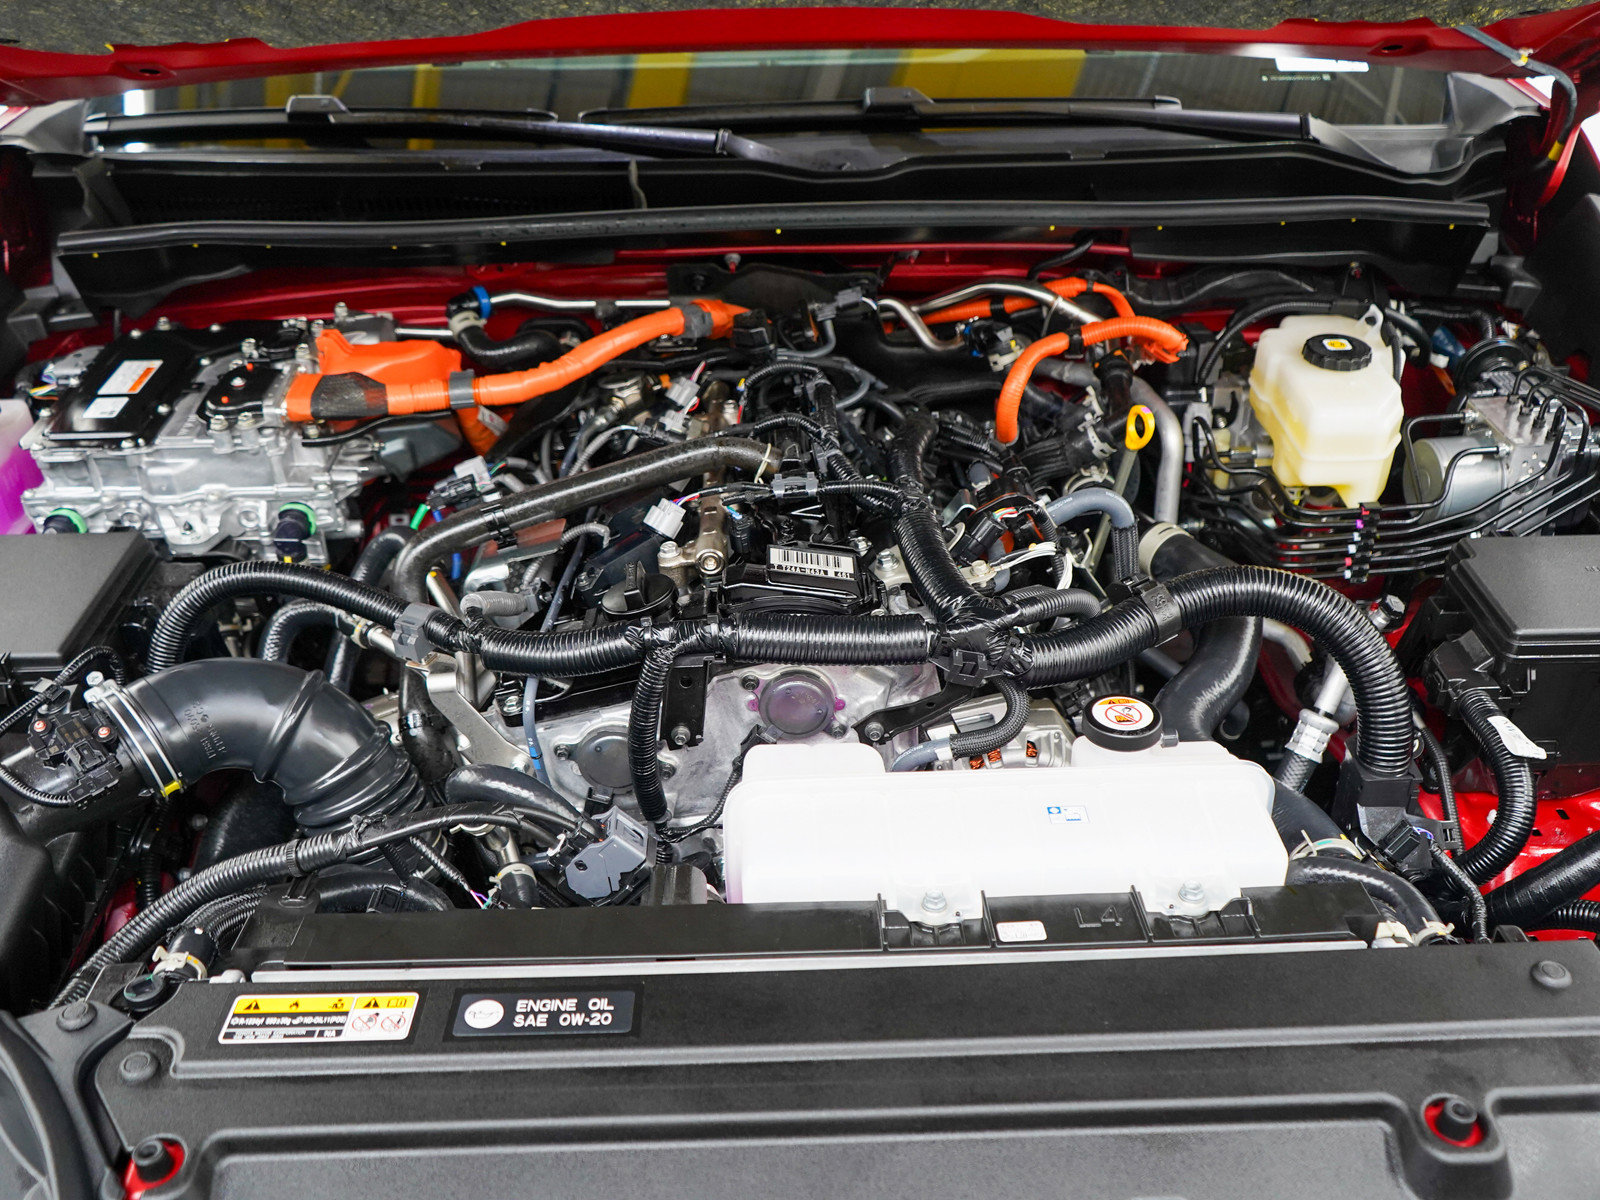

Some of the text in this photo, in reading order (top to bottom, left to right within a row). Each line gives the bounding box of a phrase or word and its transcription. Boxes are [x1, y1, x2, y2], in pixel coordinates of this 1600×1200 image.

[1073, 904, 1123, 928] L4
[515, 997, 614, 1012] ENGINE OIL
[513, 1012, 612, 1027] SAE 0W-20
